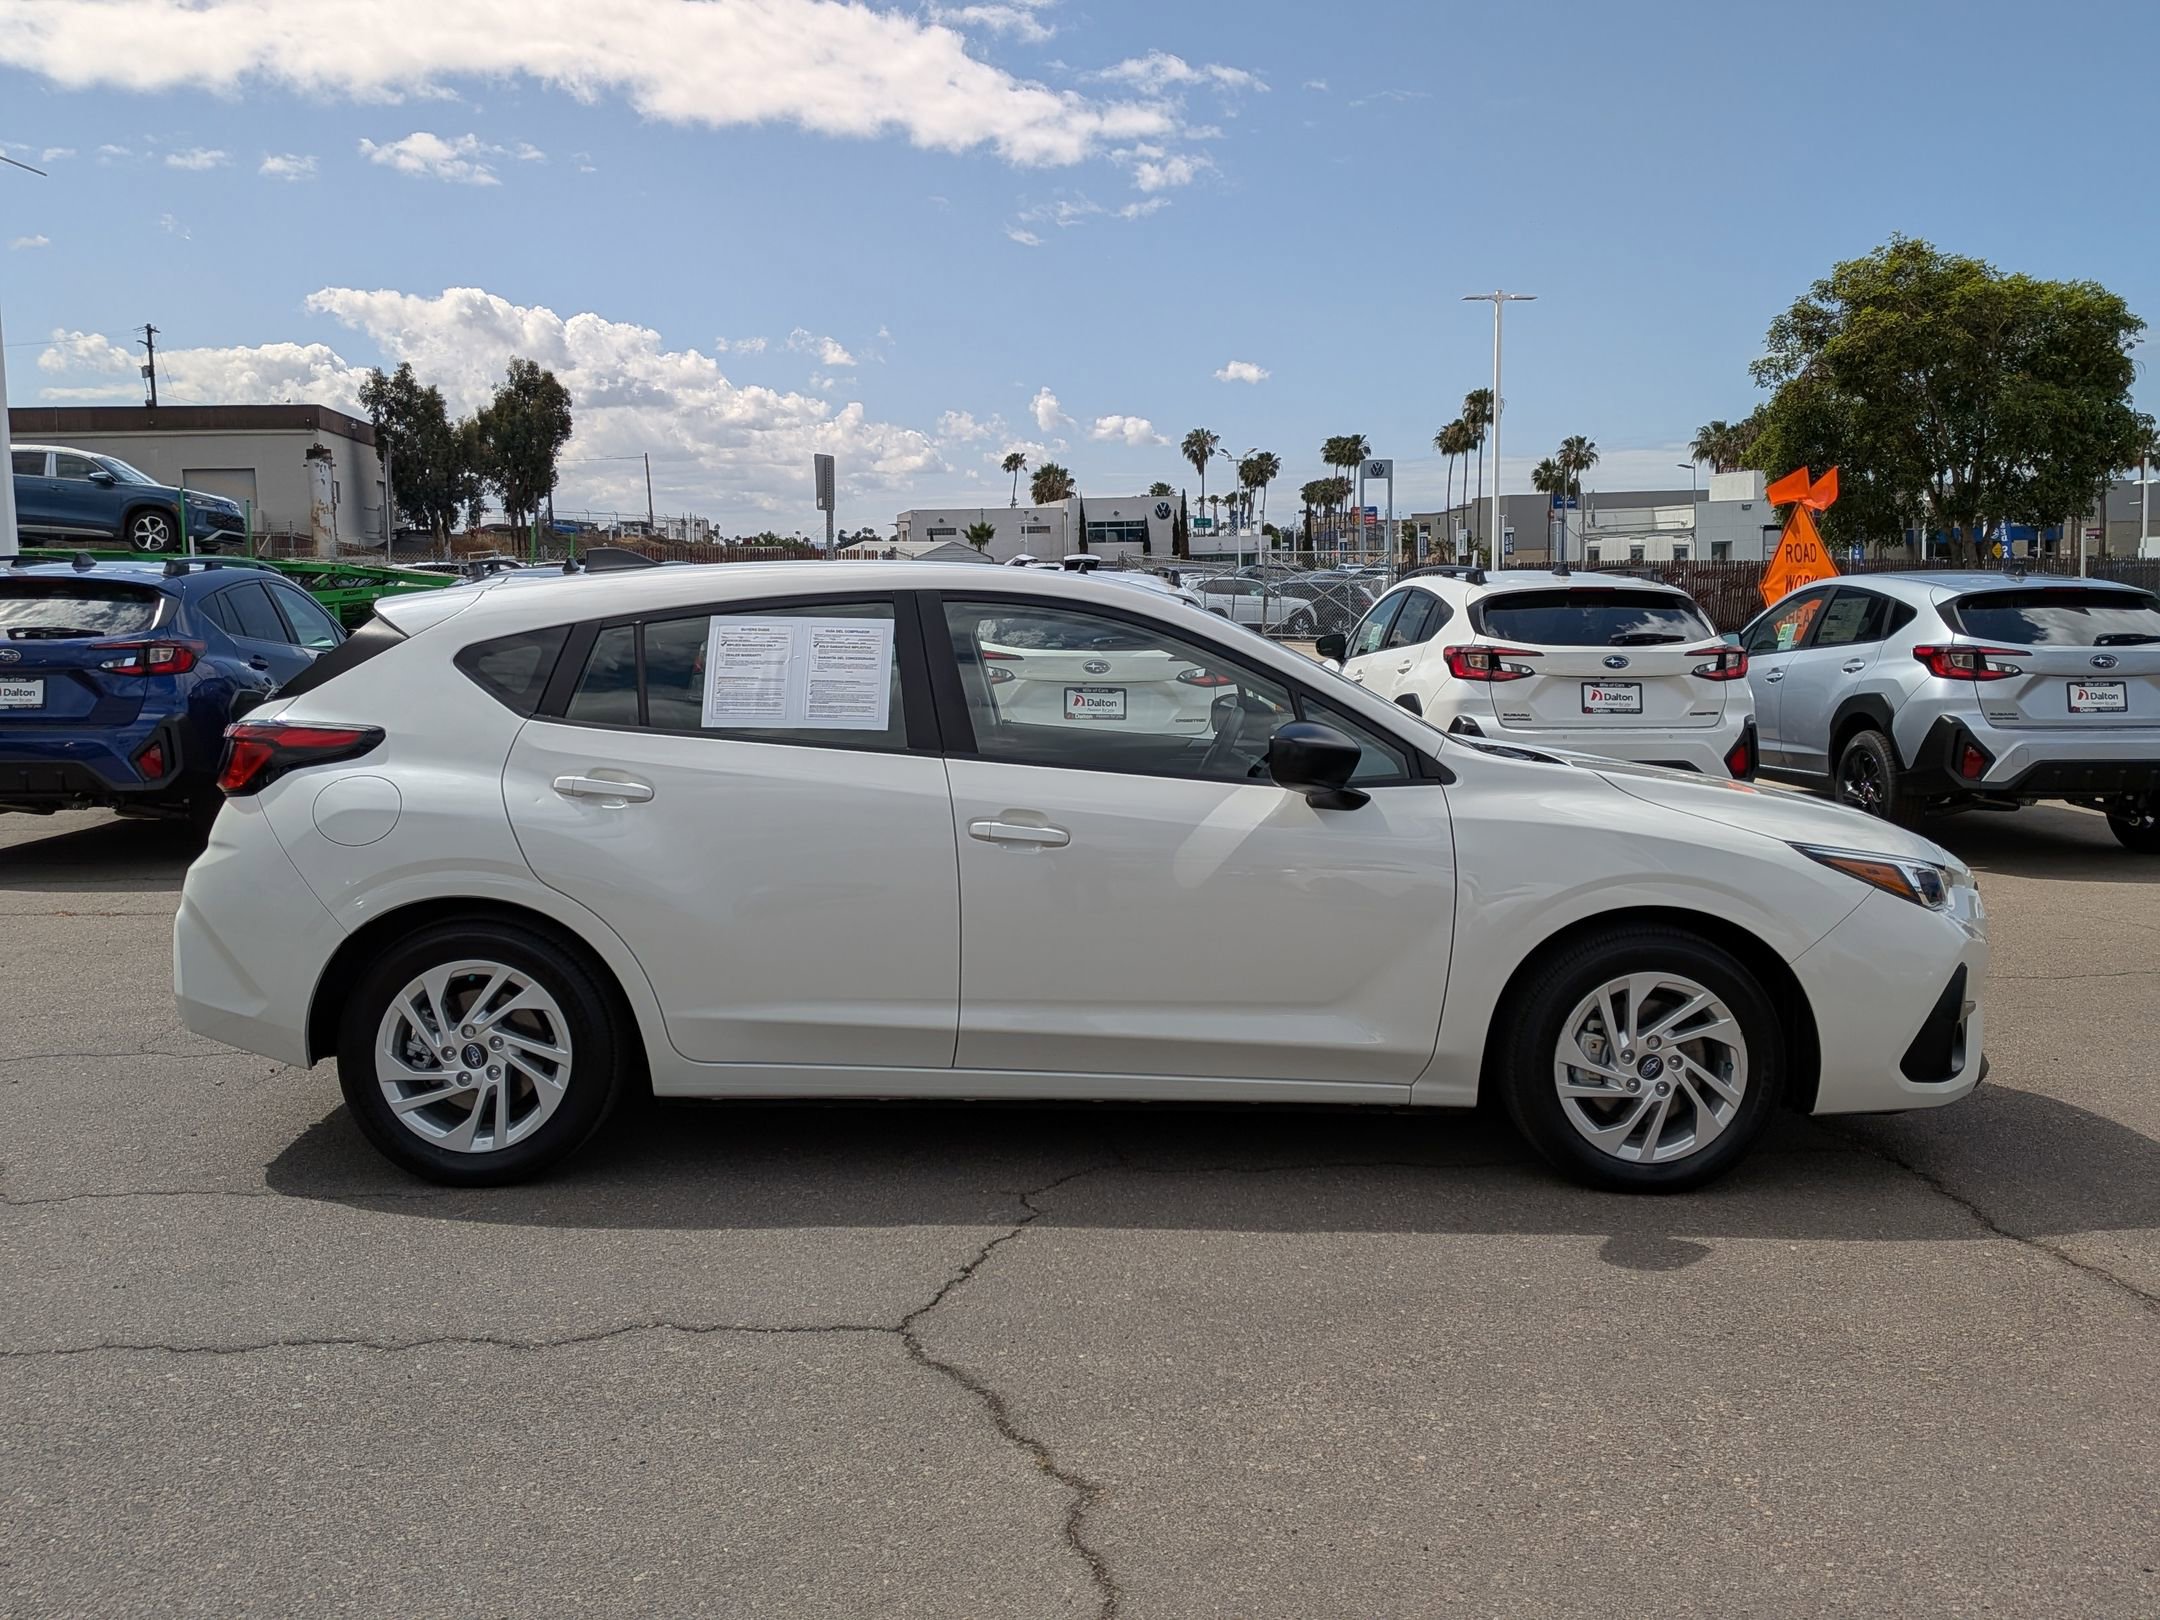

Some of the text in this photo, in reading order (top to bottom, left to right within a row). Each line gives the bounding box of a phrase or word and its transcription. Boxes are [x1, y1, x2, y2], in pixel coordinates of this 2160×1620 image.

[1785, 543, 1817, 563] ROAD
[3, 688, 36, 697] Dalton
[1604, 692, 1633, 701] Dalton
[2090, 692, 2119, 700] Dalton
[1087, 698, 1117, 707] Dalton
